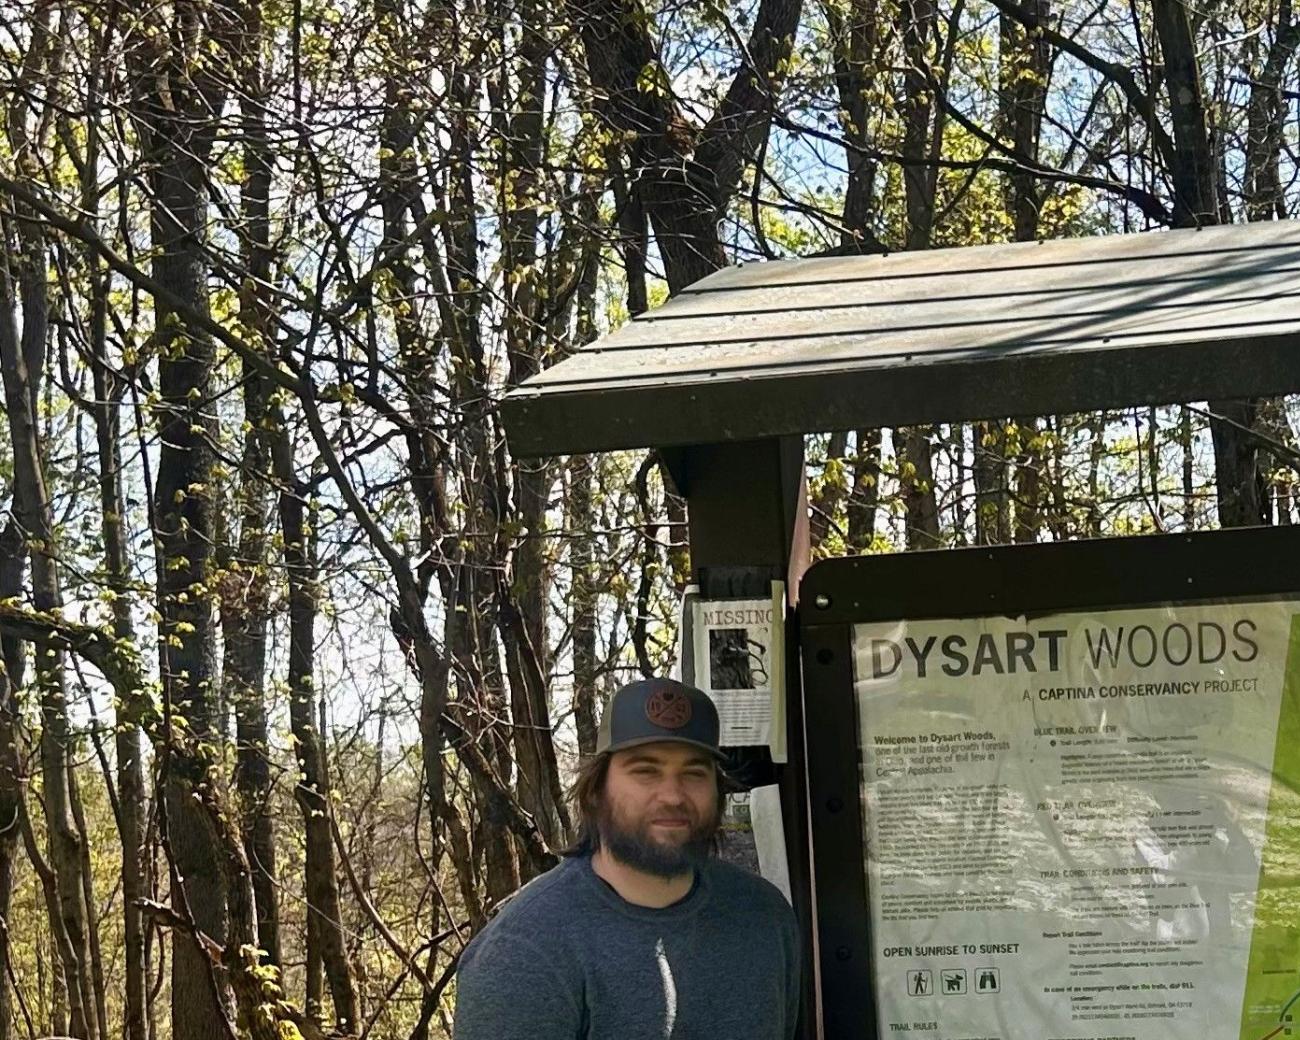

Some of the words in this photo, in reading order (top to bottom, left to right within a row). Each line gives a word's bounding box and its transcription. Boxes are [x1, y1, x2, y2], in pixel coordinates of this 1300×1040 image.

[871, 630, 1068, 679] DYSART
[1085, 619, 1259, 669] WOODS
[1039, 685, 1096, 701] CAPTINA
[1099, 682, 1200, 698] CONSERVANCY
[1204, 678, 1259, 692] PROJECT
[874, 735, 916, 745] Welcome
[919, 734, 928, 743] to
[931, 733, 961, 744] Dysart
[963, 731, 996, 742] Woods,
[883, 947, 912, 957] OPEN
[915, 945, 959, 957] SUNRISE
[963, 944, 977, 955] TO
[980, 943, 1020, 954] SUNSET
